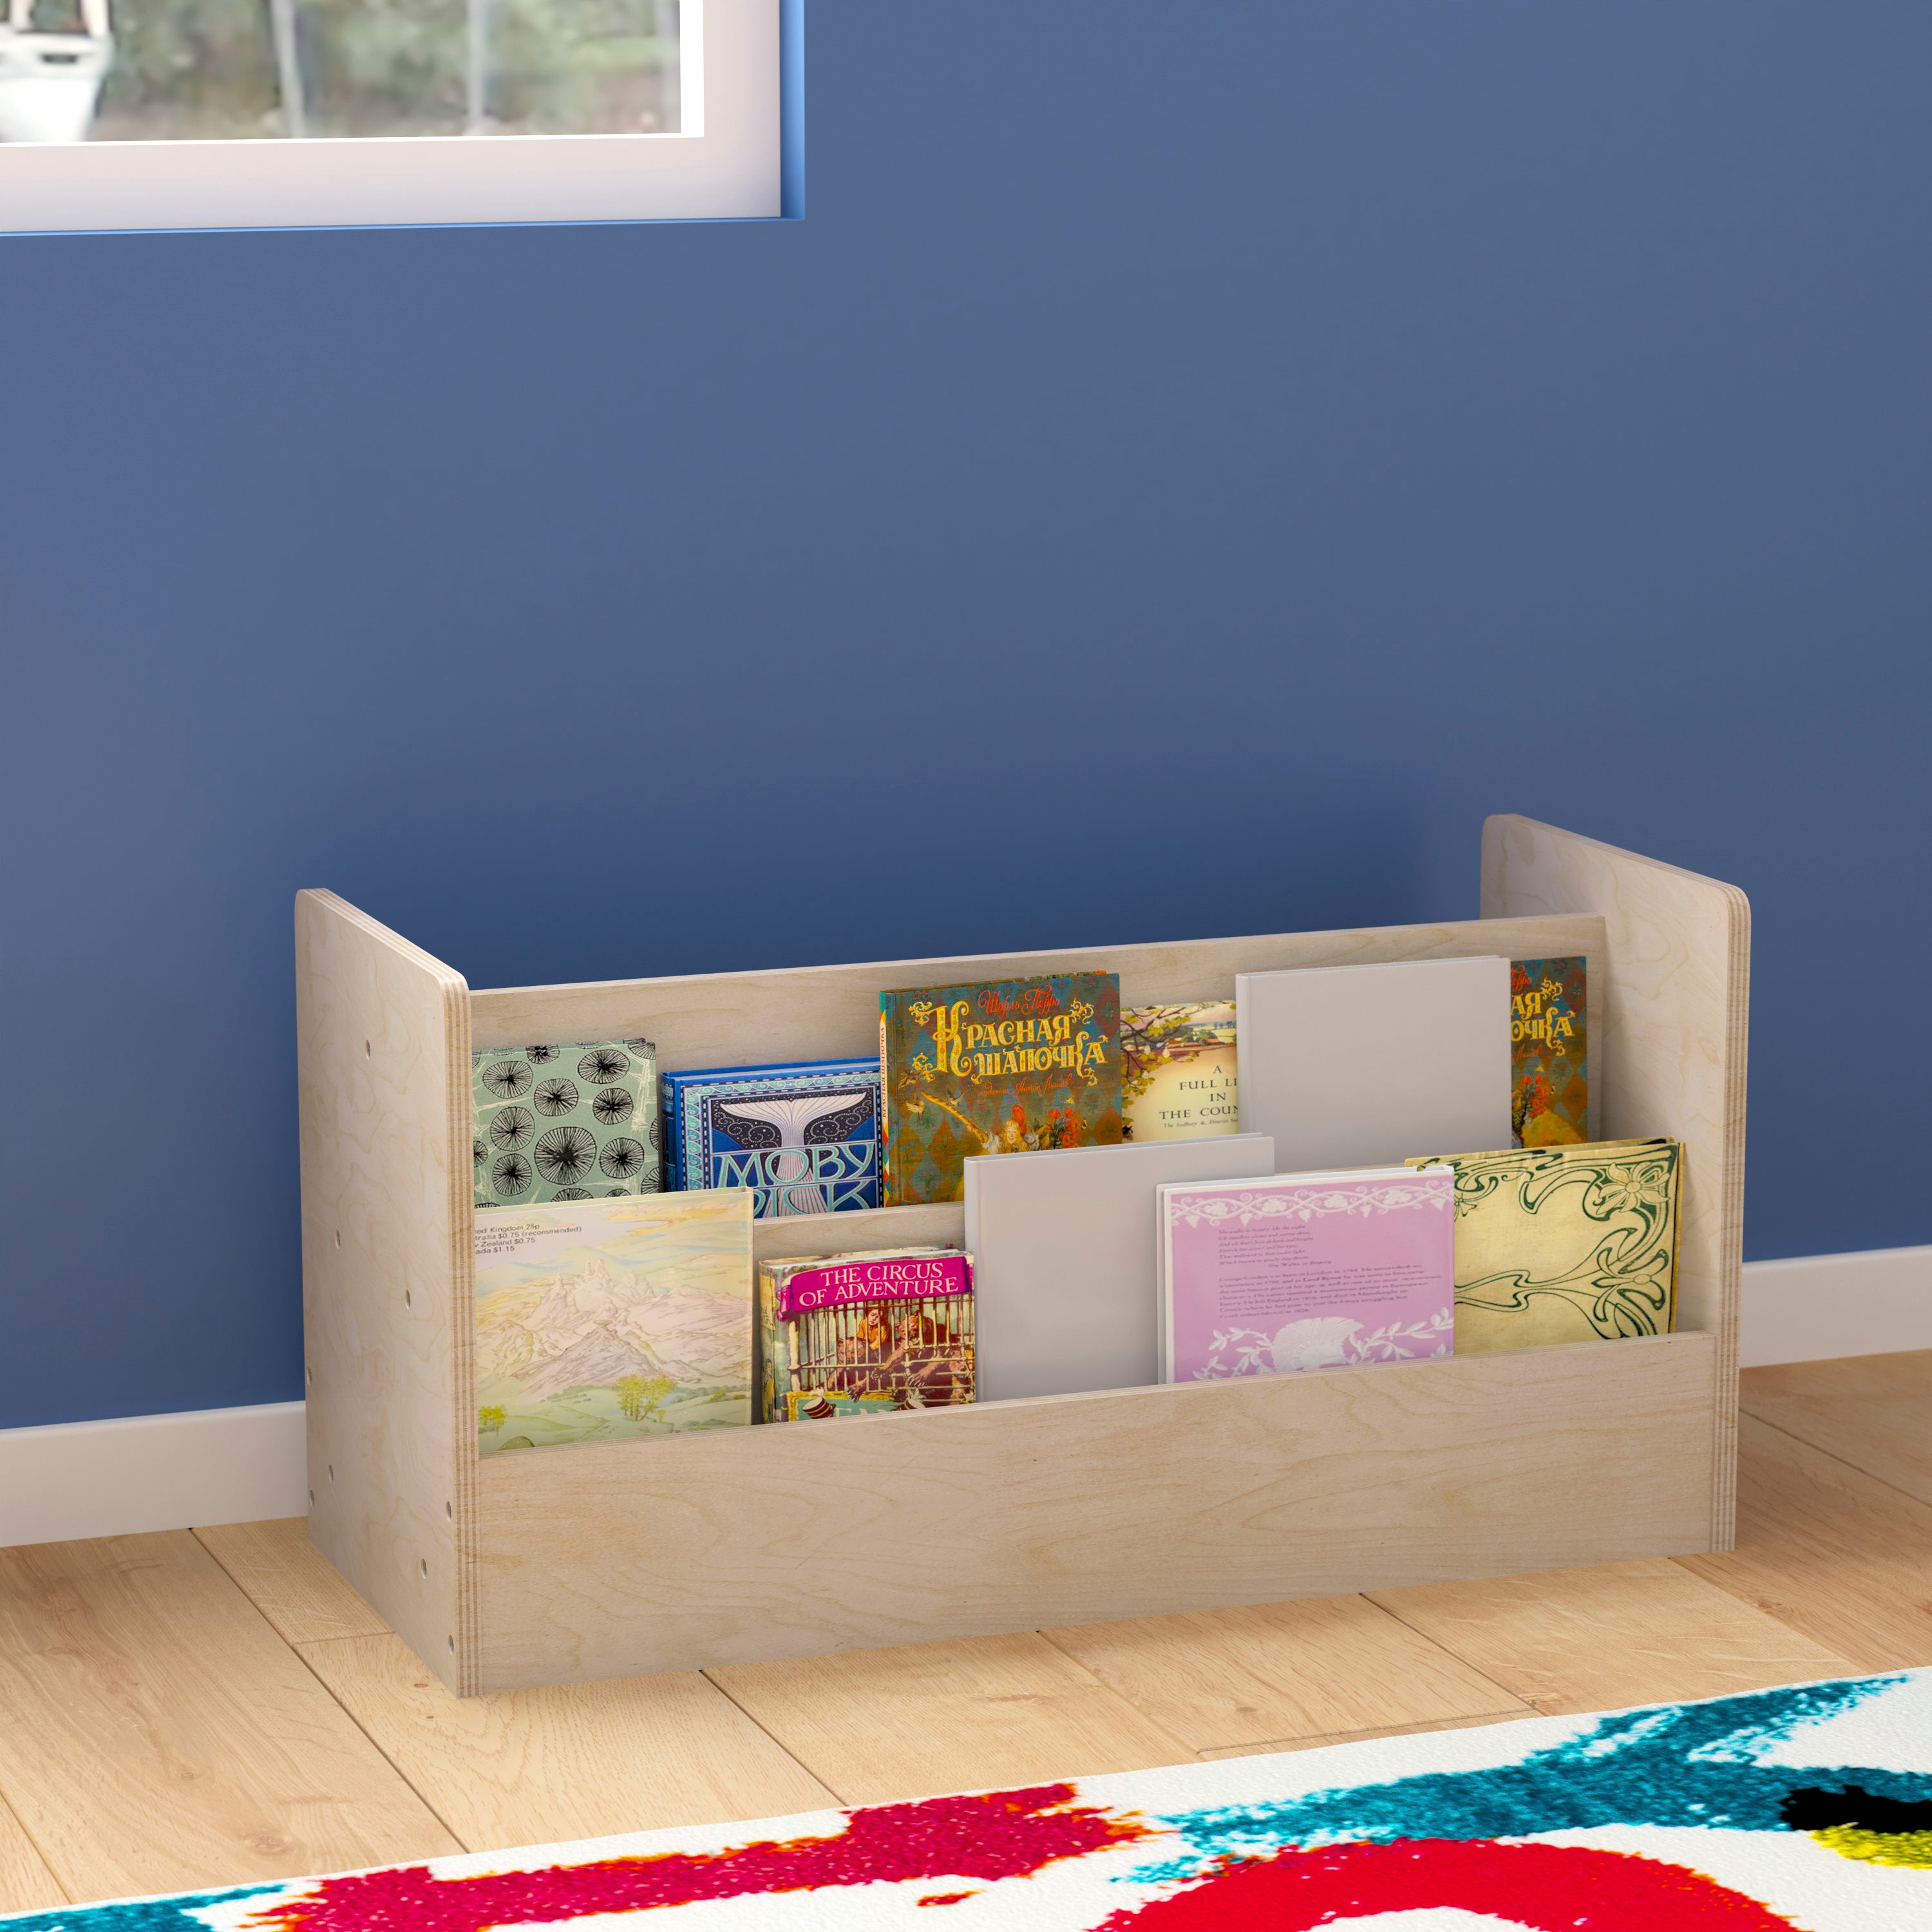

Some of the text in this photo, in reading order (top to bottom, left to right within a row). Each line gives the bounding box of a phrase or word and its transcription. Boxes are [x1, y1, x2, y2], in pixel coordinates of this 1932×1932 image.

[1510, 1007, 1576, 1050] ОЧКА
[1213, 1065, 1222, 1074] A
[1179, 1077, 1237, 1090] FULL LI
[1210, 1092, 1226, 1102] IN
[1159, 1105, 1238, 1119] THE COUN
[717, 1142, 876, 1189] MOBY
[522, 1226, 582, 1238] (recommended)
[480, 1239, 513, 1247] Zealand
[820, 1262, 943, 1287] THE CIRCUS
[799, 1276, 959, 1307] OF ADVENTURE
